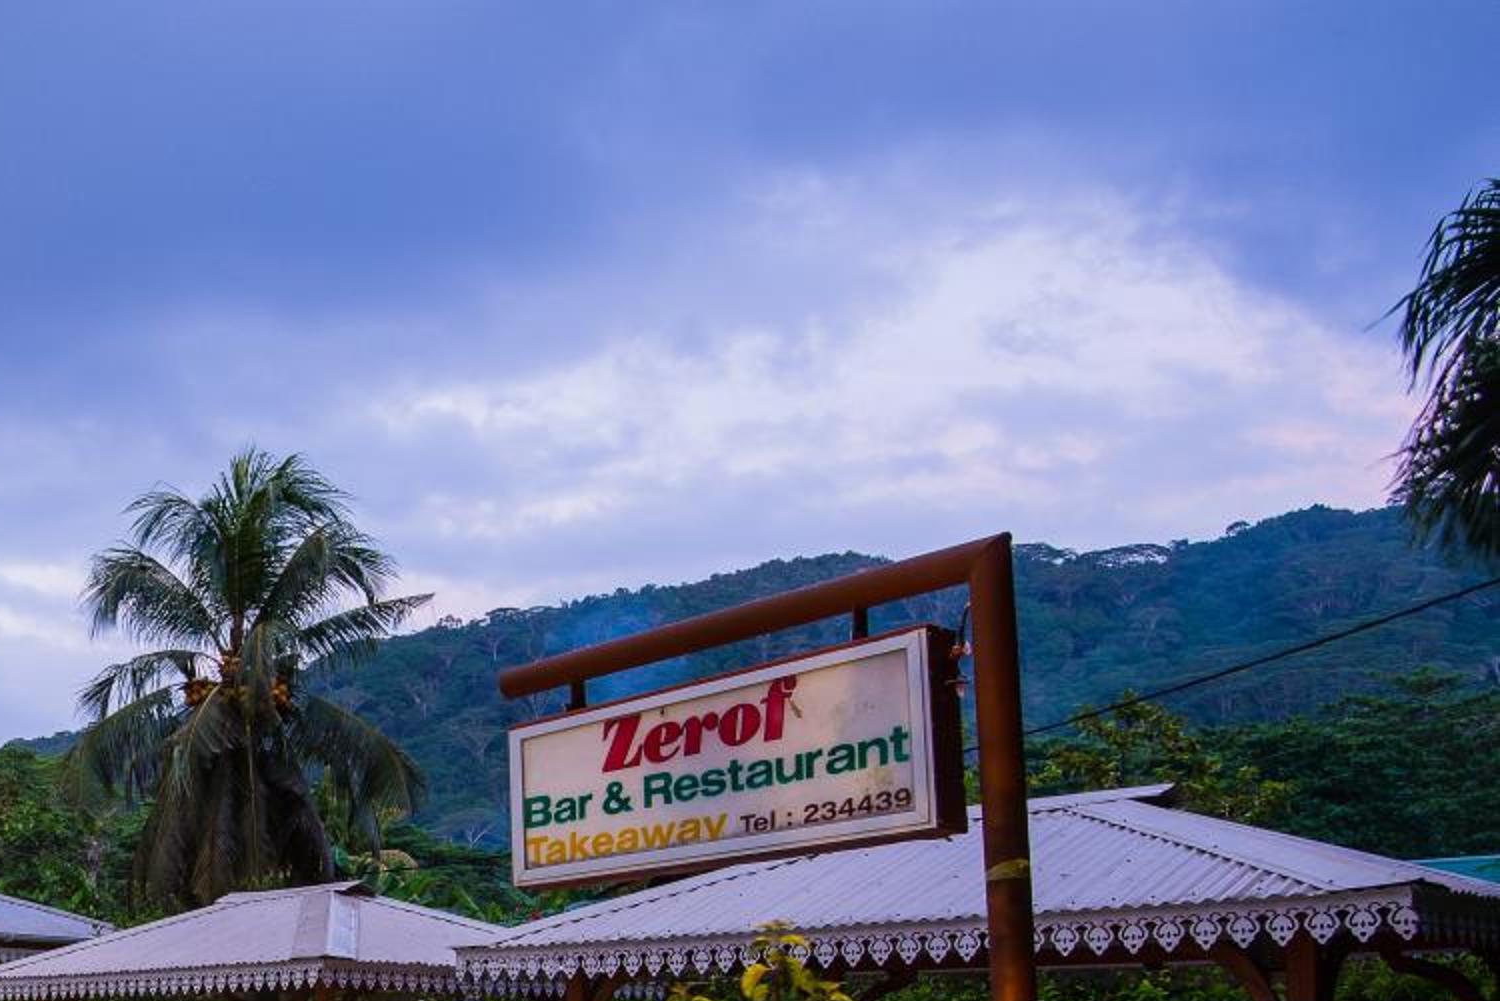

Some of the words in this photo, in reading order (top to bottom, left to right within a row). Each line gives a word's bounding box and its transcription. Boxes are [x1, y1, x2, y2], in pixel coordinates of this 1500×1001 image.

[602, 675, 797, 772] Zerof
[524, 794, 593, 828] Bar
[603, 781, 632, 814] &
[644, 725, 910, 808] Restaurant
[527, 810, 728, 864] Takeaway
[803, 788, 911, 823] 234439
